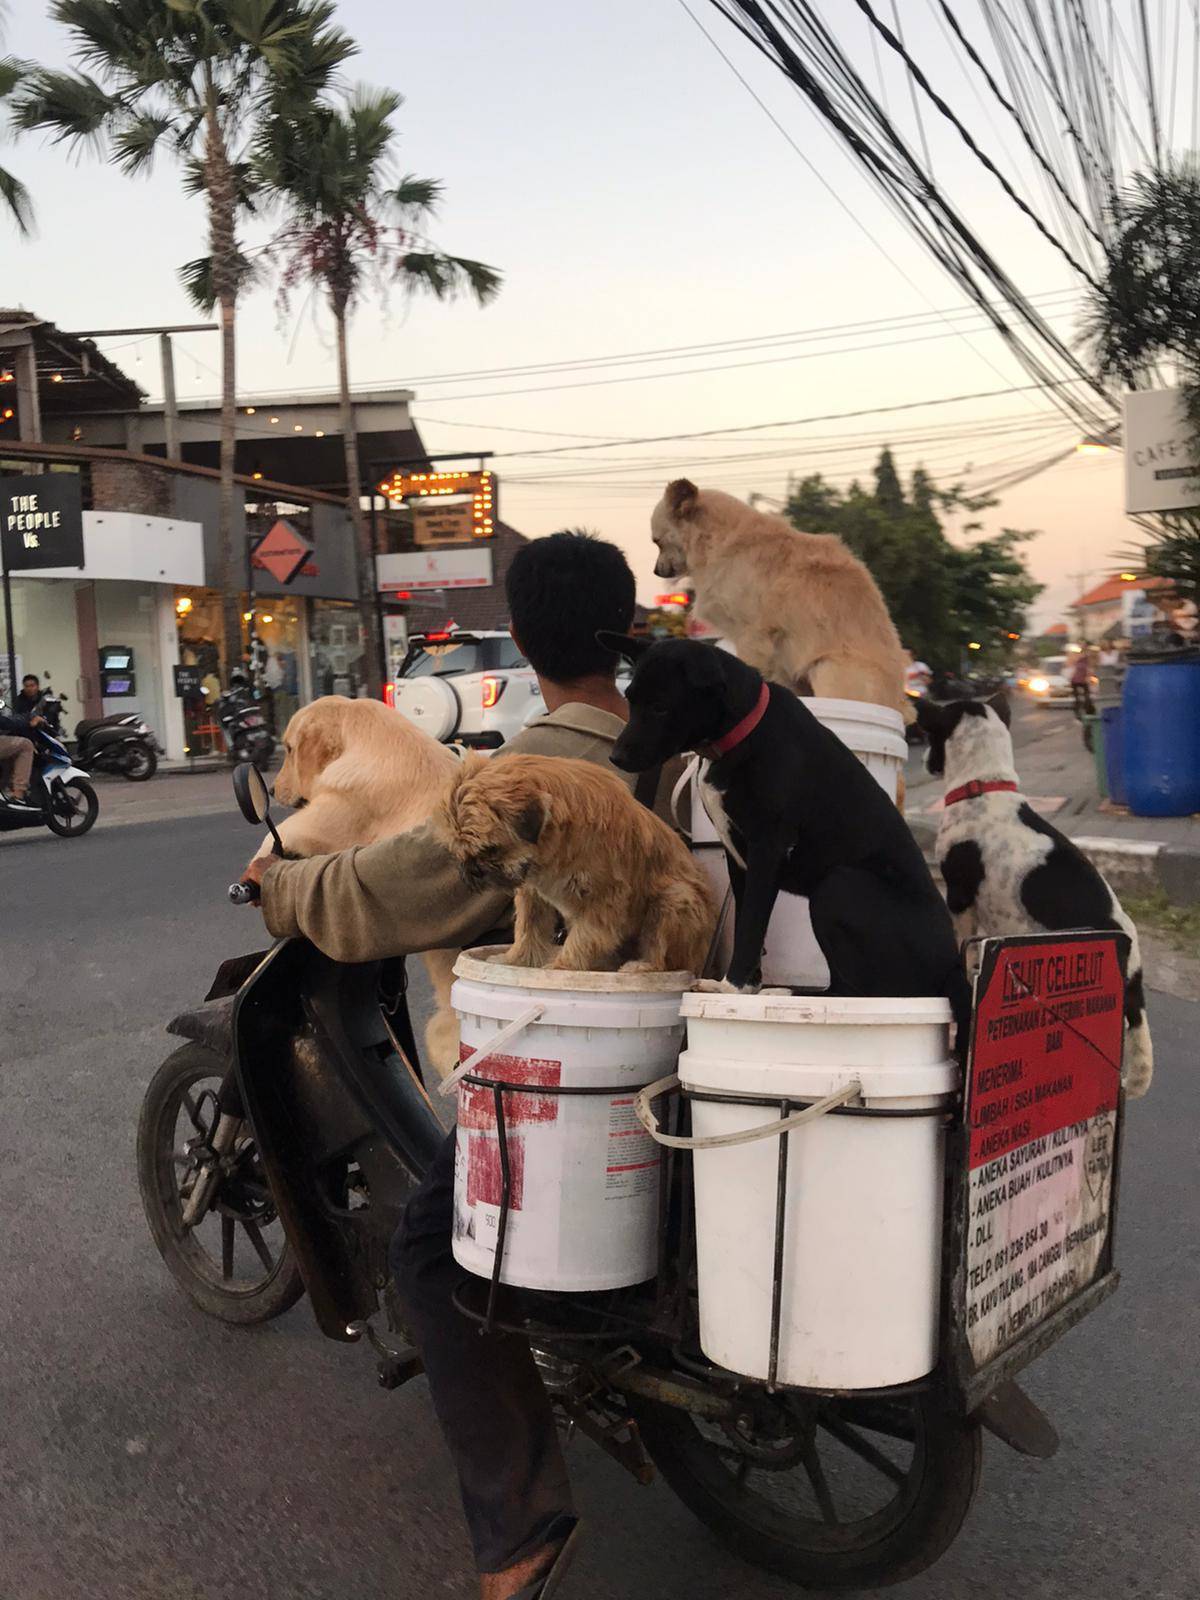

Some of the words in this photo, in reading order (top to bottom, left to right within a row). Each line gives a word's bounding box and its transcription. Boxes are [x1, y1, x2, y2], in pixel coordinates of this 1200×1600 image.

[10, 494, 39, 513] THE
[7, 510, 61, 531] PEOPLE
[978, 1156, 1008, 1189] ANEKA
[1009, 1137, 1048, 1172] SAYURAN
[1052, 1120, 1089, 1149] KULITNYA
[980, 1127, 1009, 1158] ANEKA
[976, 1184, 1007, 1218] ANEKA
[1008, 1169, 1031, 1199] BUAH
[1036, 1148, 1073, 1182] KULITNYA
[975, 1221, 992, 1248] DLL
